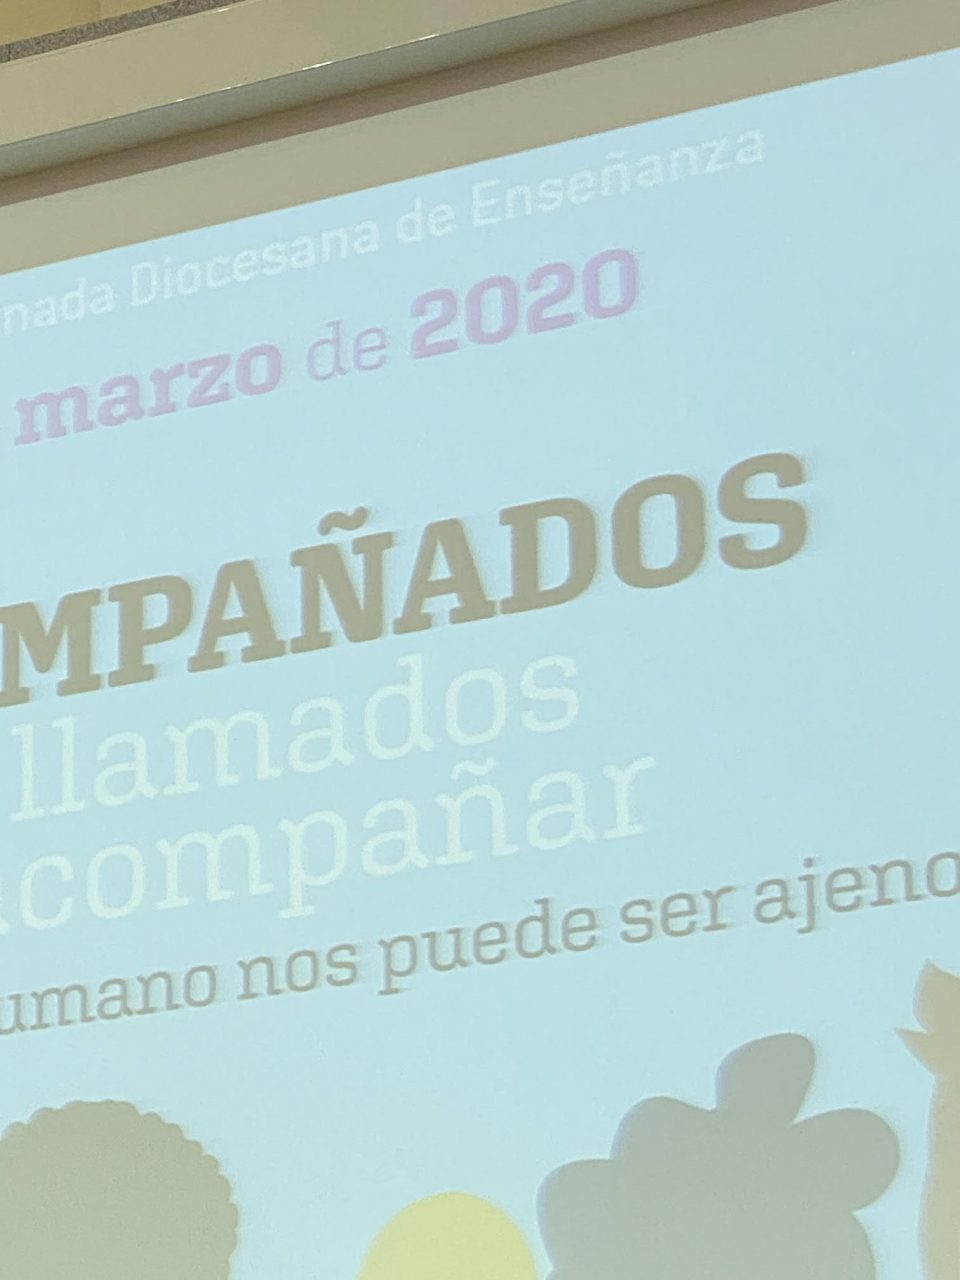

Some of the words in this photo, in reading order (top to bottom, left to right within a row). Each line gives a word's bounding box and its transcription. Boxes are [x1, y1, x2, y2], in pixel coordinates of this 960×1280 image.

[130, 217, 383, 307] Diocesana
[396, 199, 456, 245] de
[471, 127, 766, 229] Enseñanza
[14, 342, 284, 446] marzo
[306, 320, 390, 382] de
[409, 248, 639, 360] 2020
[9, 652, 581, 822] llamados
[236, 942, 359, 999] nos
[377, 898, 600, 997] puede
[619, 885, 737, 944] ser
[752, 850, 960, 935] ajeno
